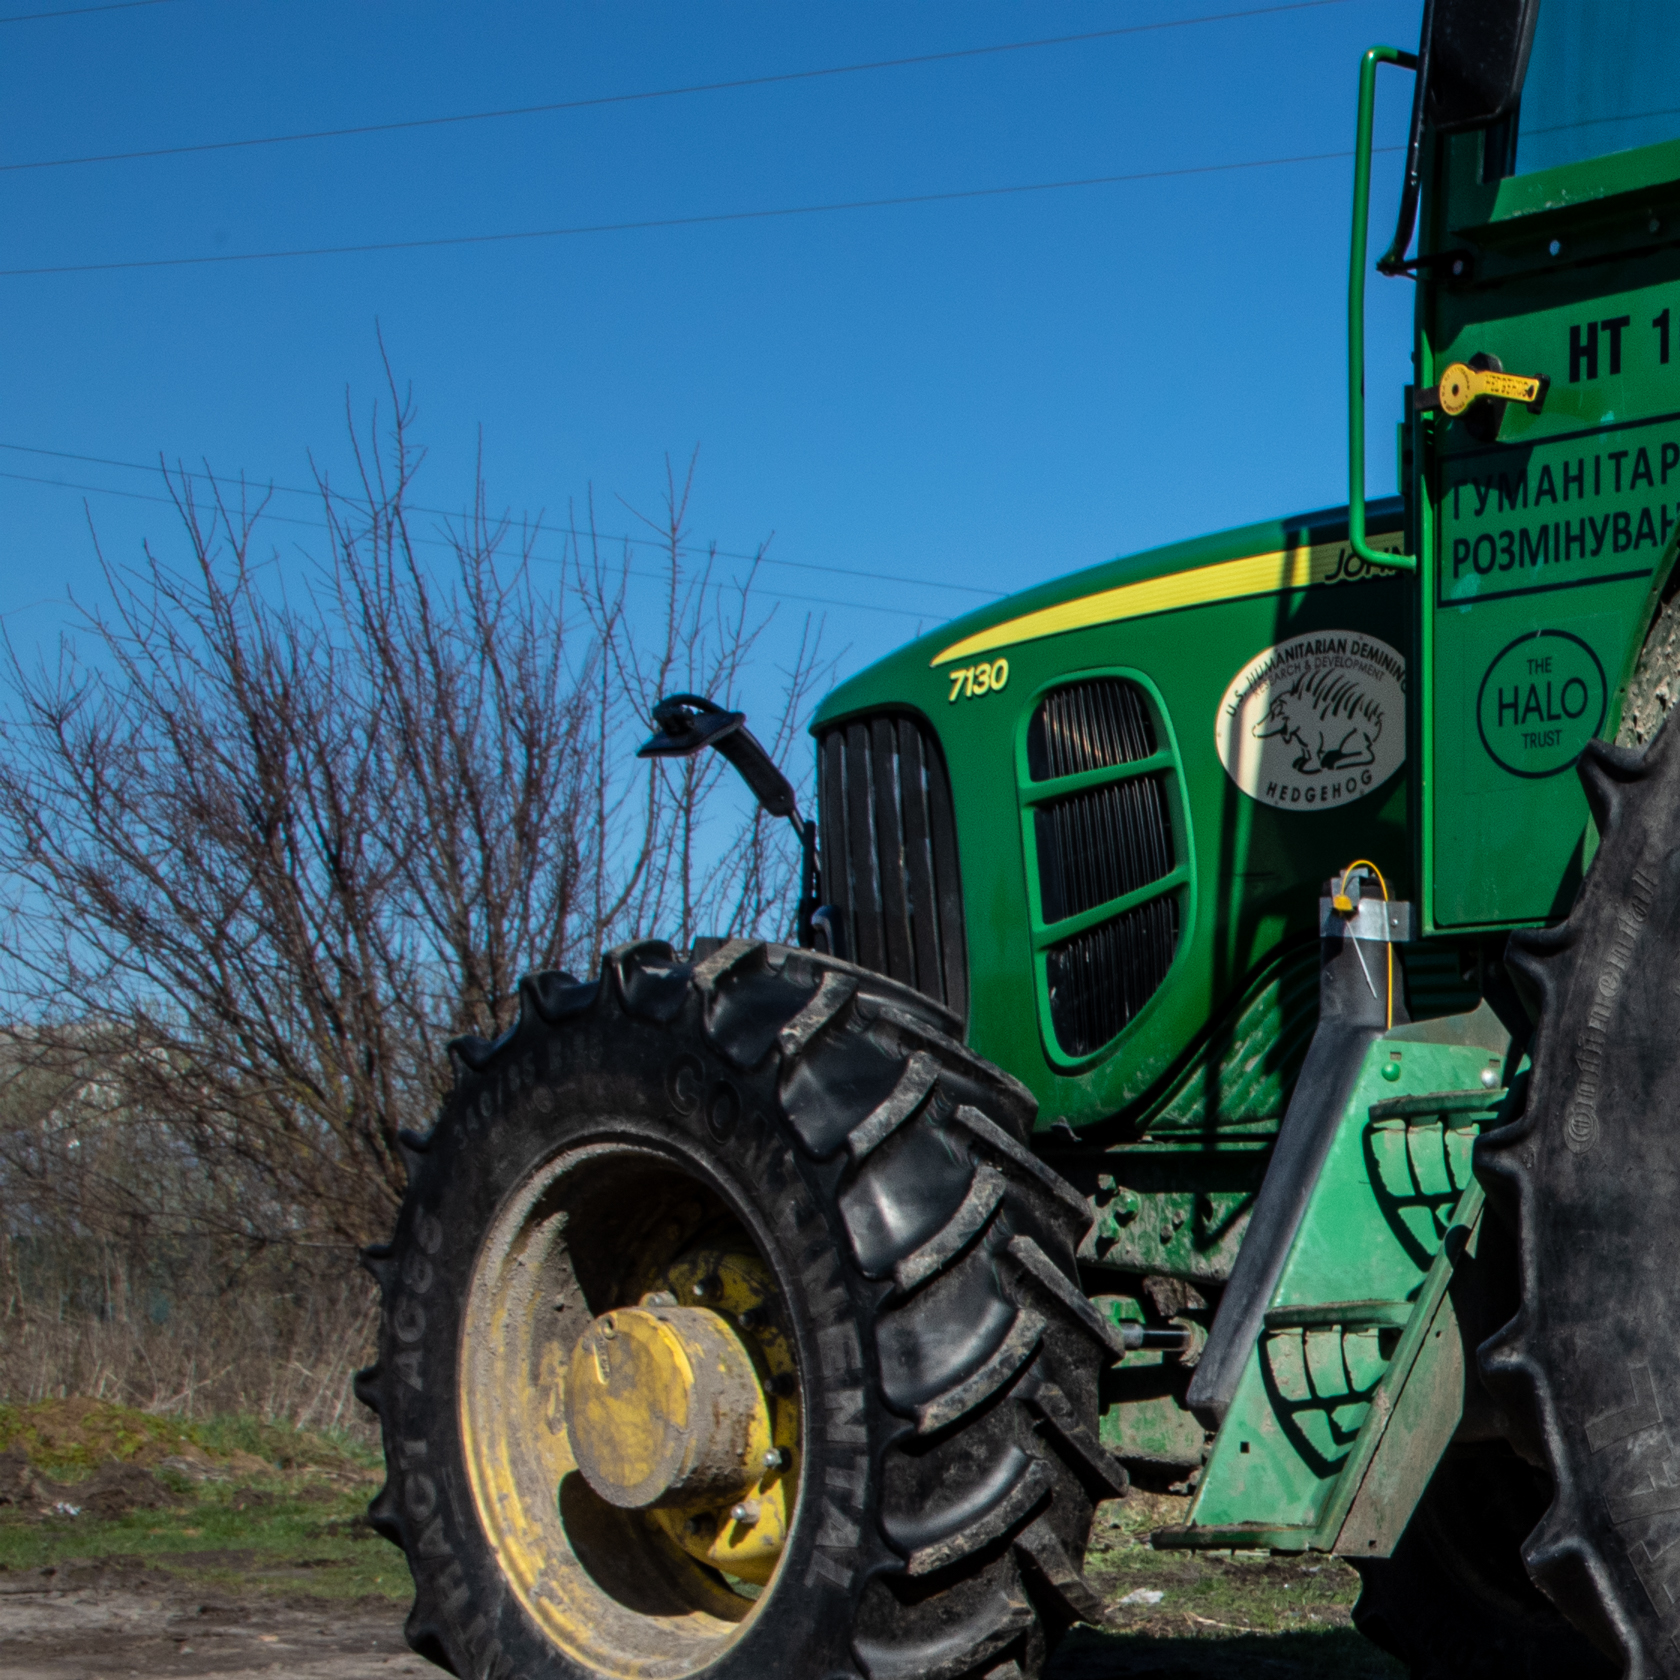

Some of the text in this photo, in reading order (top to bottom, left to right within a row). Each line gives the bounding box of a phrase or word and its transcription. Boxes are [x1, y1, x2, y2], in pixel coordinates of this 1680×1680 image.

[948, 657, 1010, 703] 7130
[1246, 638, 1347, 689] HUMANITARIAN
[1315, 656, 1386, 682] DEVELOPMENT
[1526, 656, 1553, 676] THE
[1498, 675, 1589, 728] HALO
[1521, 728, 1564, 751] TRUST
[1266, 769, 1373, 803] HEDGEHOG
